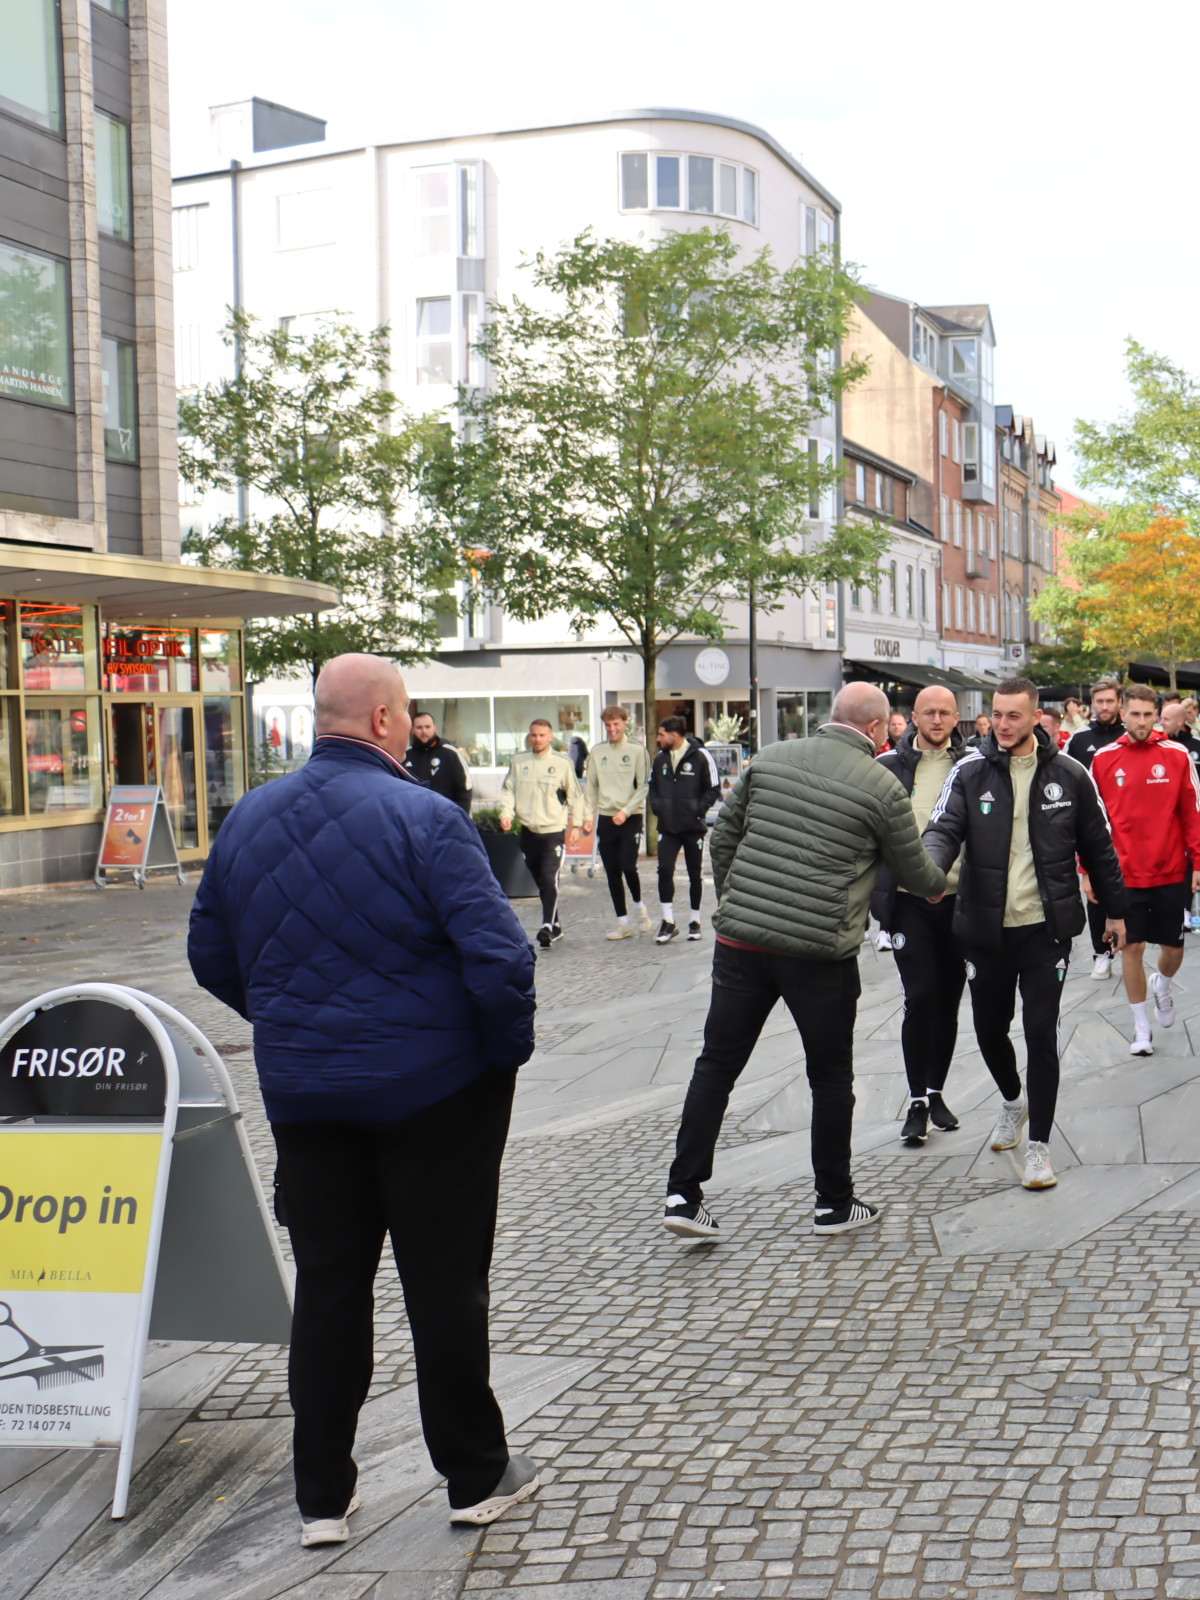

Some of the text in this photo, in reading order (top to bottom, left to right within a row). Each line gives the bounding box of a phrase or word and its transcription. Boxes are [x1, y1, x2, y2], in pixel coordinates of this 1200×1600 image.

[2, 364, 62, 386] ANDLÆGE
[30, 383, 62, 397] HANSEN
[135, 640, 187, 657] OPTIK
[107, 662, 154, 675] BY SYNSAM
[114, 808, 146, 821] 2 for 1
[11, 1047, 126, 1077] FRISØR
[95, 1082, 148, 1091] DIN FRISØR
[98, 1185, 138, 1225] in
[9, 1269, 92, 1281] MIA BELLA
[0, 1403, 111, 1417] DEN TIDSBESTILLING
[11, 1420, 25, 1431] 72
[28, 1420, 40, 1431] 14
[42, 1421, 56, 1431] 07
[58, 1421, 71, 1432] 74
